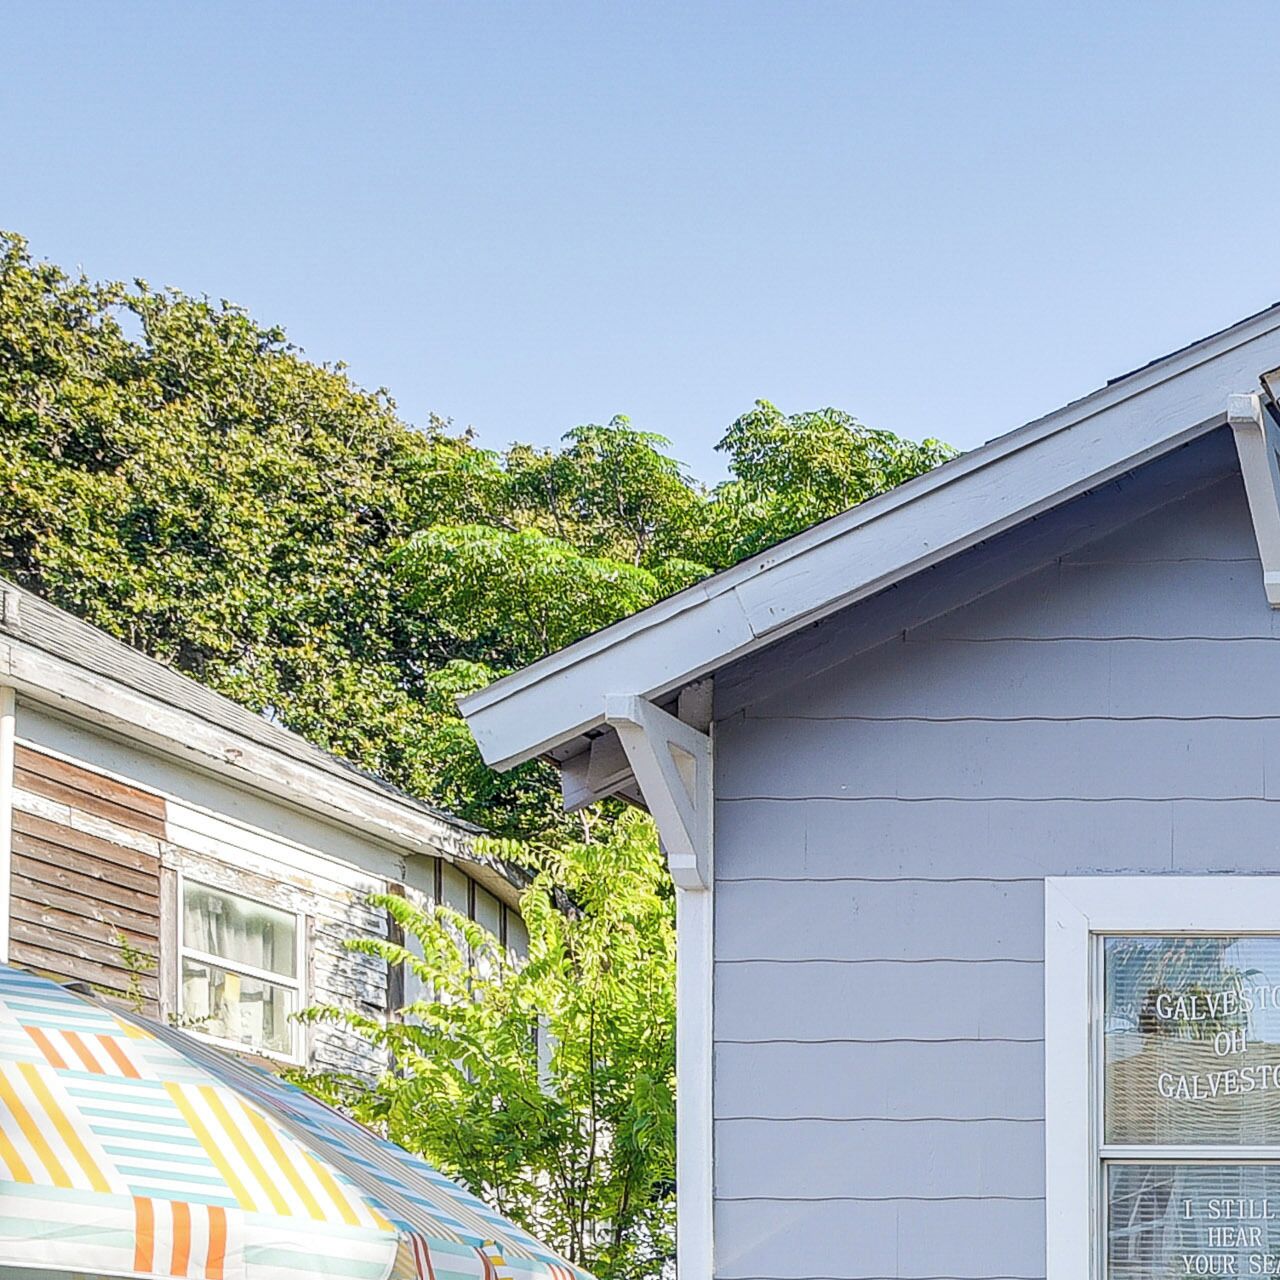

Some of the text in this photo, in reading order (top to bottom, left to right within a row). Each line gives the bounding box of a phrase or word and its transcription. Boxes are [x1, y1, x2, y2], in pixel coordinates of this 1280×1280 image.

[1214, 1029, 1248, 1057] OH
[1183, 1199, 1275, 1220] I STILL
[1208, 1226, 1262, 1247] HEAR
[1182, 1254, 1236, 1275] YOUR
